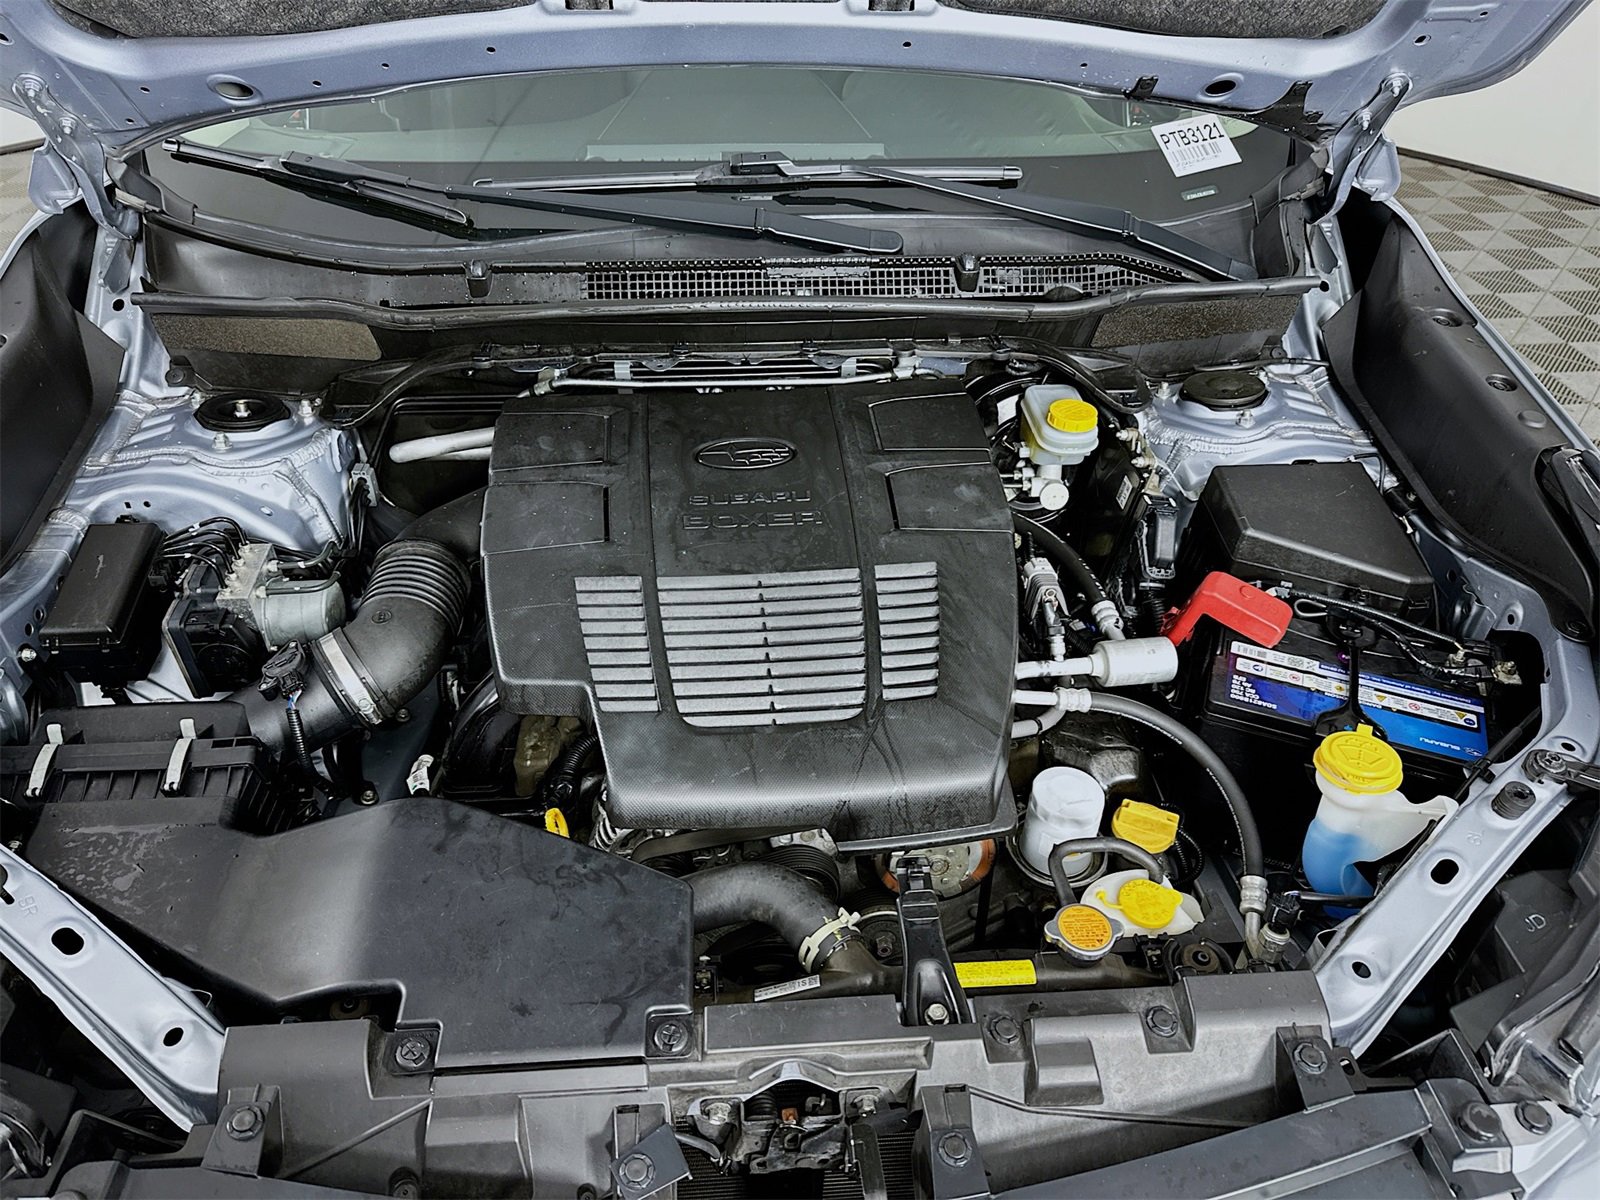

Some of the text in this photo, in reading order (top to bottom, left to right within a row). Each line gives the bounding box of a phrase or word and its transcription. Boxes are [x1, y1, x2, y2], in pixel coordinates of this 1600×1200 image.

[1160, 122, 1225, 150] PTB3121
[689, 490, 811, 506] SUBARU
[683, 510, 823, 530] BOXER
[1419, 736, 1461, 751] SUBARU
